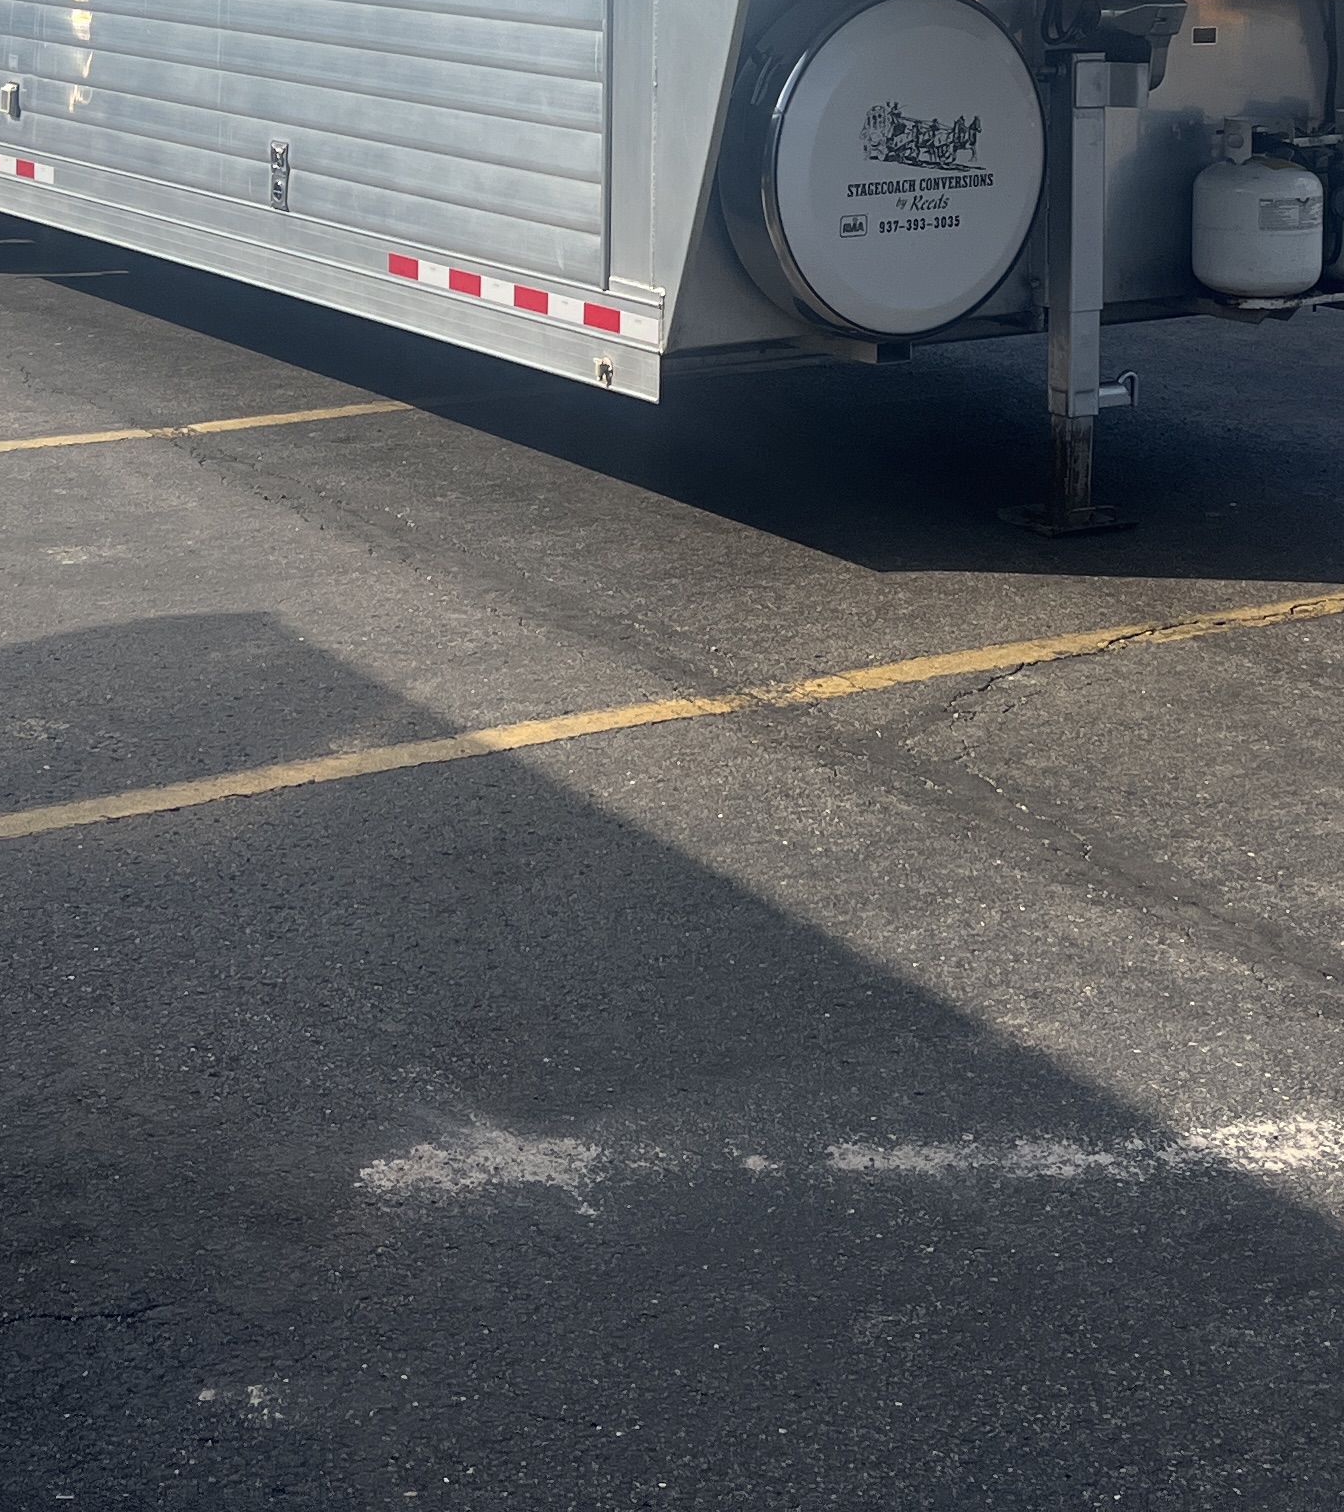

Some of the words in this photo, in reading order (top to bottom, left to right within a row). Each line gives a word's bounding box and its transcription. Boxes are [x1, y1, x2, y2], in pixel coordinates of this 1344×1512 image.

[847, 180, 916, 197] STAGECOACH
[919, 173, 994, 191] CONVERSIONS
[896, 196, 907, 210] by
[879, 215, 960, 233] 937-393-3035
